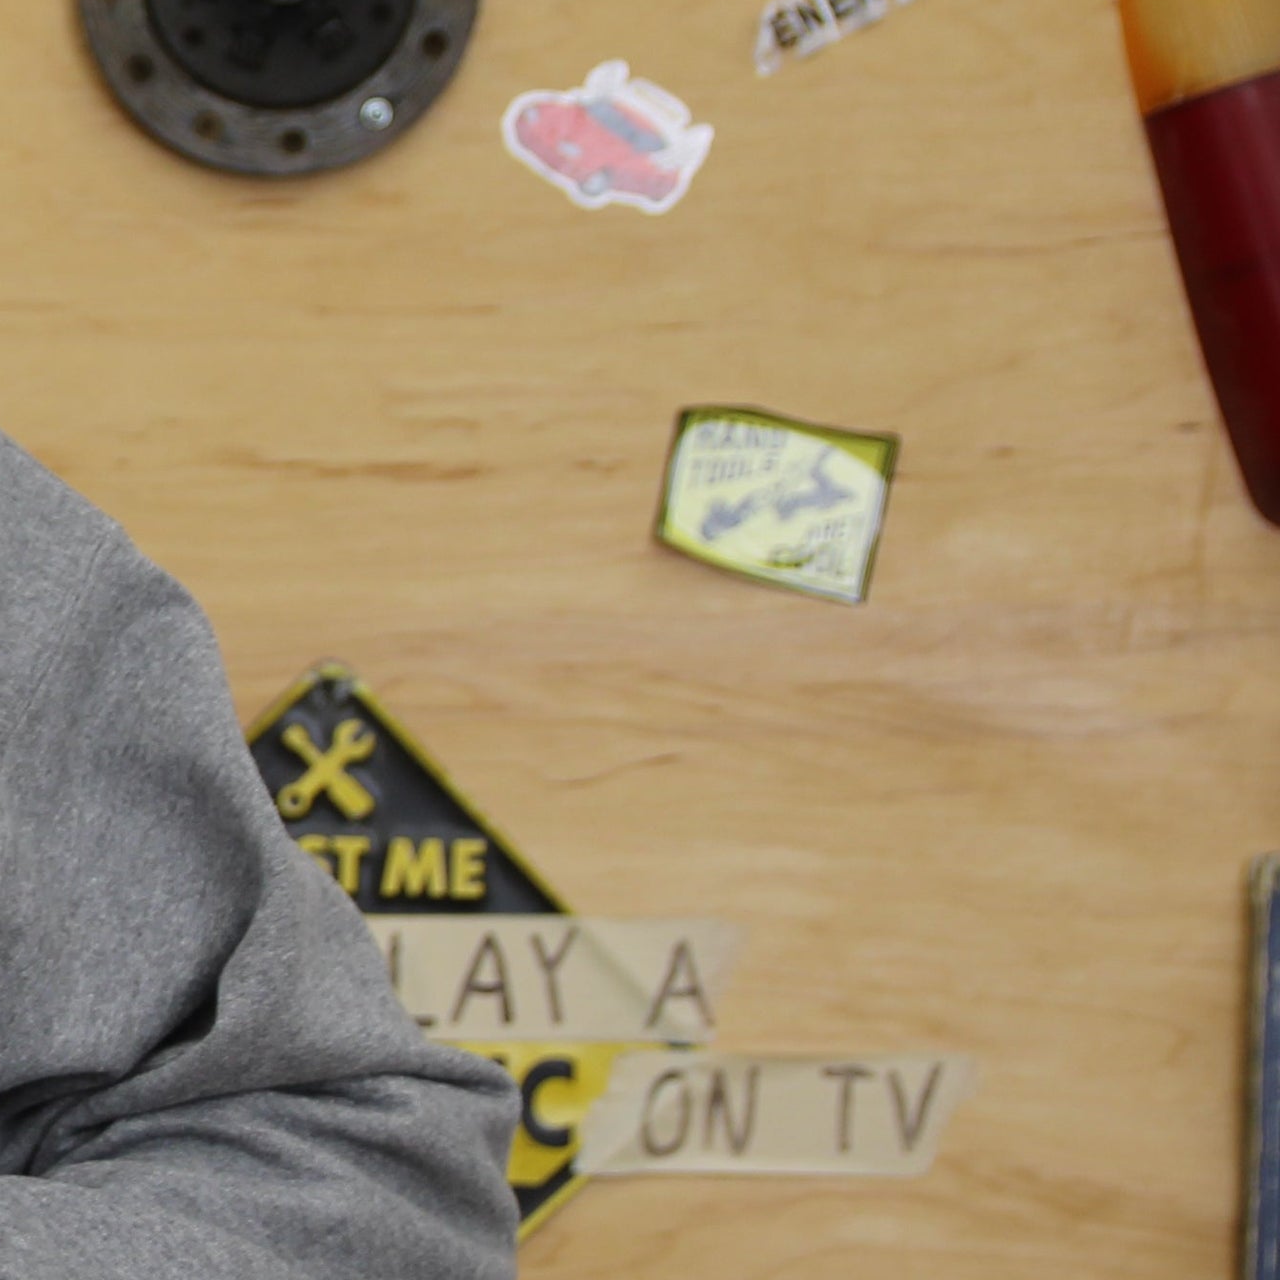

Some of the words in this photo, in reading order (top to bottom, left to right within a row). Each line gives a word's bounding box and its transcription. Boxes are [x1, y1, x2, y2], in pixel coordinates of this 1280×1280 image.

[380, 836, 489, 900] ME
[389, 925, 579, 1027] LAY
[645, 937, 716, 1028] A
[641, 1065, 761, 1157] ON
[822, 1061, 944, 1154] TV
